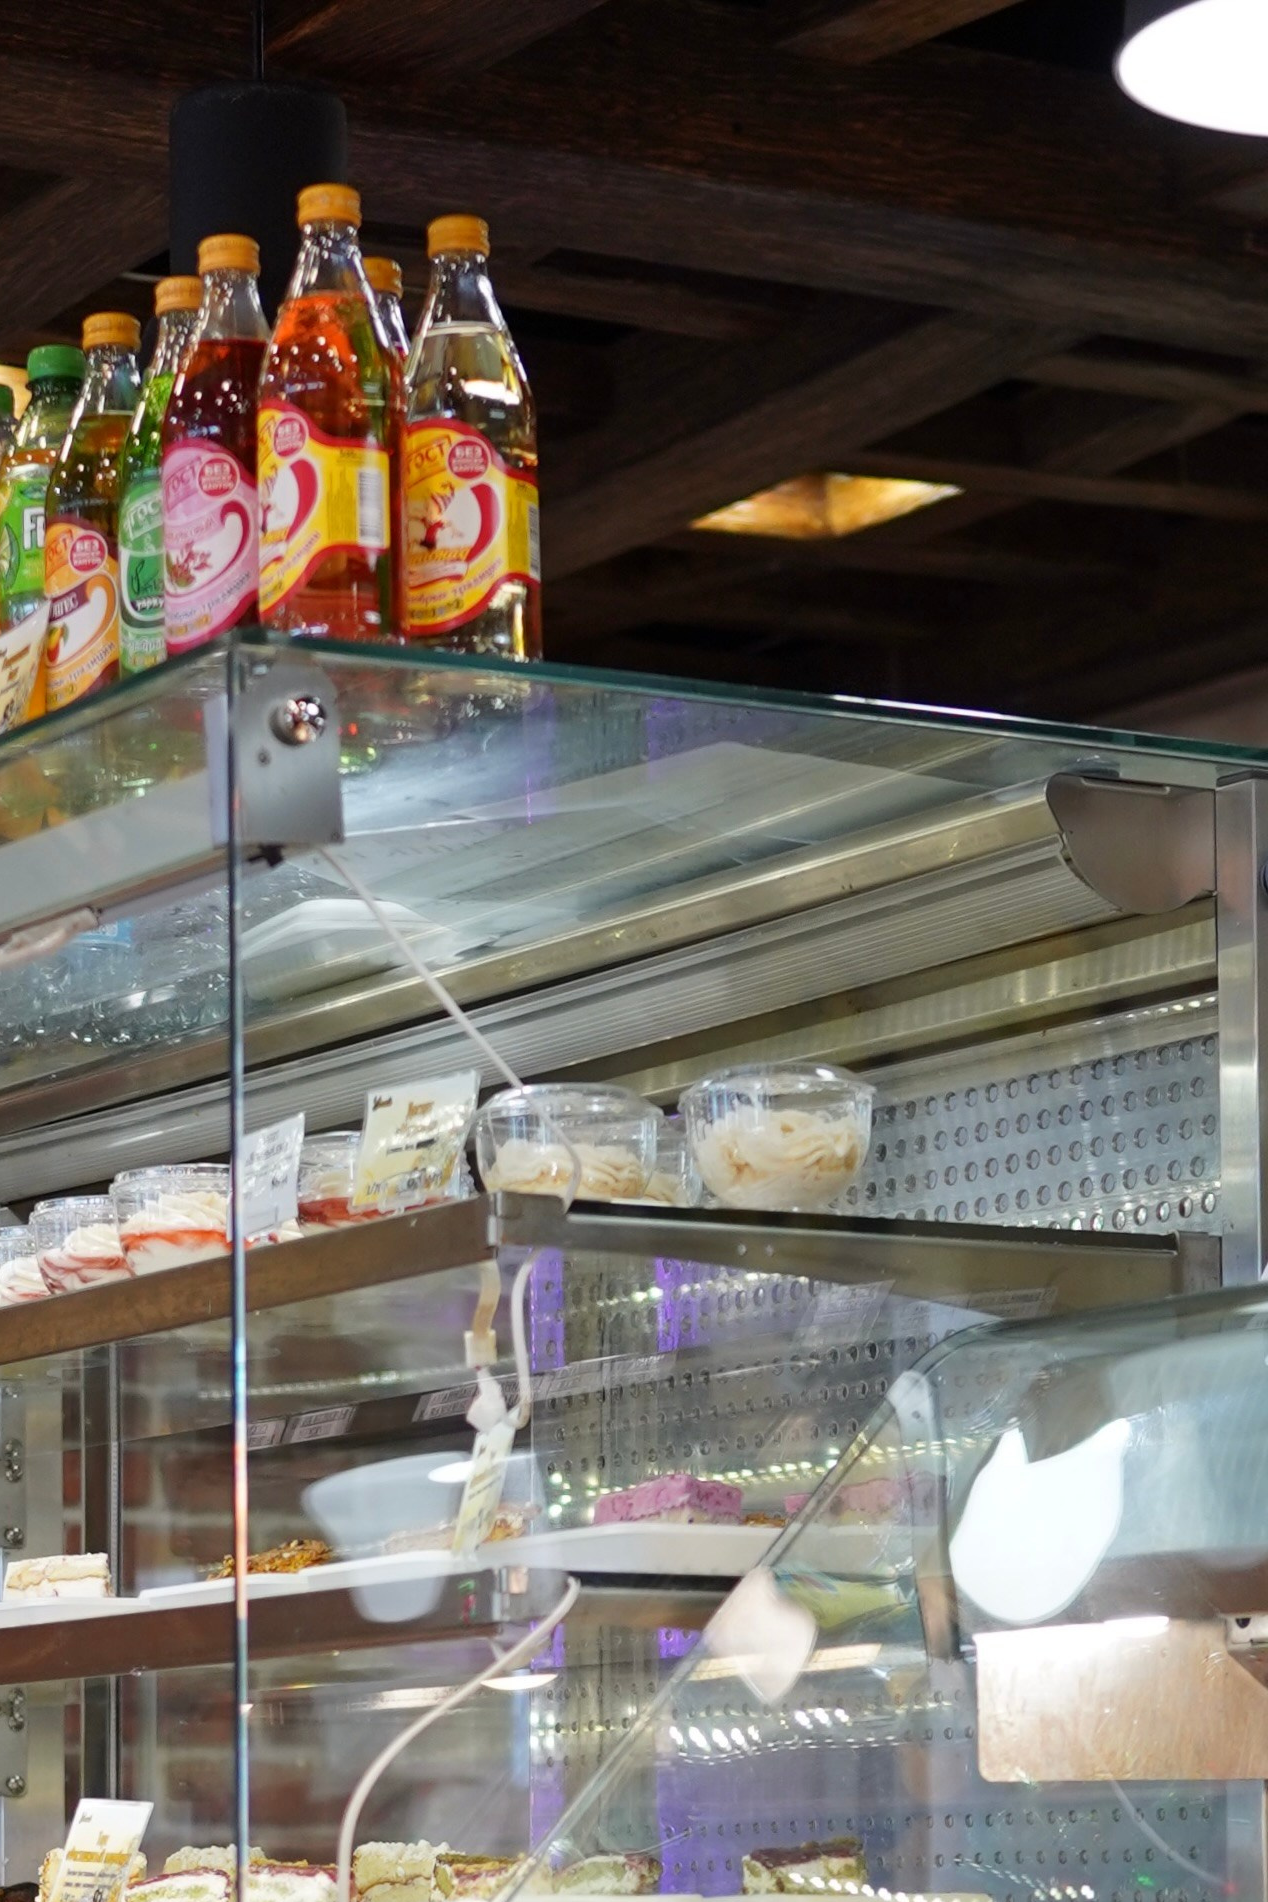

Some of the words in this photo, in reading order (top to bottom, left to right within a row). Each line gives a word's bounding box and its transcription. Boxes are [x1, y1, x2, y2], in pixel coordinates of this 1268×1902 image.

[454, 445, 483, 458] БЕЗ
[204, 463, 231, 475] БЕЗ
[75, 539, 100, 551] БЕЗ
